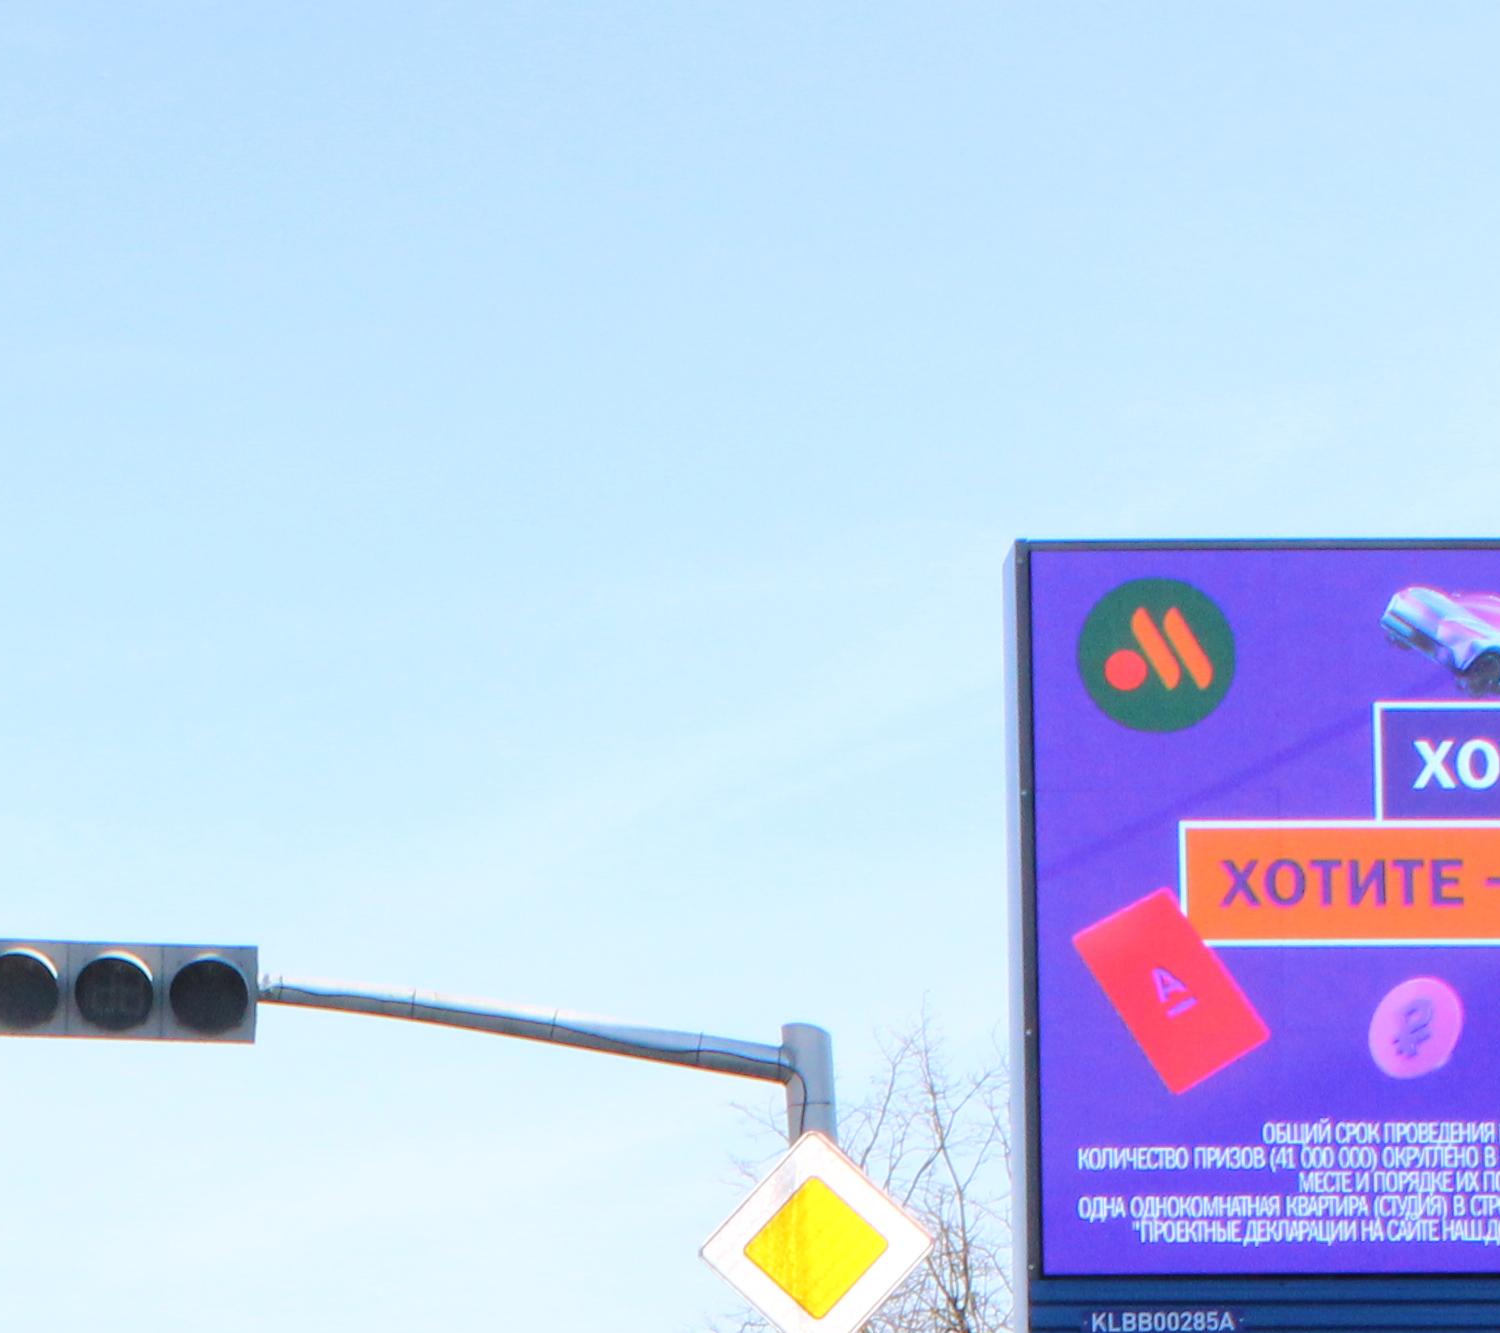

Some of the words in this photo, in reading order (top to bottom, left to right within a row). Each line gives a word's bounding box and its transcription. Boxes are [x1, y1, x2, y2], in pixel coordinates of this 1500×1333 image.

[1221, 858, 1466, 908] ХОТИТЕ
[1262, 1119, 1331, 1148] ОБЩИЙ
[1335, 1122, 1379, 1144] СРОК
[1383, 1122, 1495, 1148] ПРОВЕДЕНИЯ
[1078, 1148, 1189, 1170] КОЛИЧЕСТВО
[1194, 1148, 1265, 1170] ПРИЗОВ
[1270, 1148, 1295, 1174] (41
[1301, 1148, 1333, 1170] 000
[1338, 1148, 1377, 1174] 000)
[1382, 1148, 1478, 1170] ОКРУГЛЕНО
[1485, 1148, 1497, 1170] В
[1300, 1172, 1351, 1193] МЕСТЕ
[1355, 1172, 1370, 1193] И
[1373, 1172, 1454, 1197] ПОРЯДКЕ
[1457, 1172, 1478, 1193] ИХ
[1078, 1197, 1126, 1222] ОДНА
[1130, 1197, 1281, 1222] ОДНОКОМНАТНАЯ
[1285, 1197, 1370, 1218] КВАРТИРА
[1373, 1197, 1449, 1222] (СТУДИЯ)
[1453, 1197, 1466, 1218] В
[1242, 1220, 1357, 1247] ДЕКЛАРАЦИИ
[1361, 1220, 1384, 1243] НА
[1386, 1217, 1440, 1243] САЙТЕ
[1090, 1310, 1235, 1333] KLBB00285A
